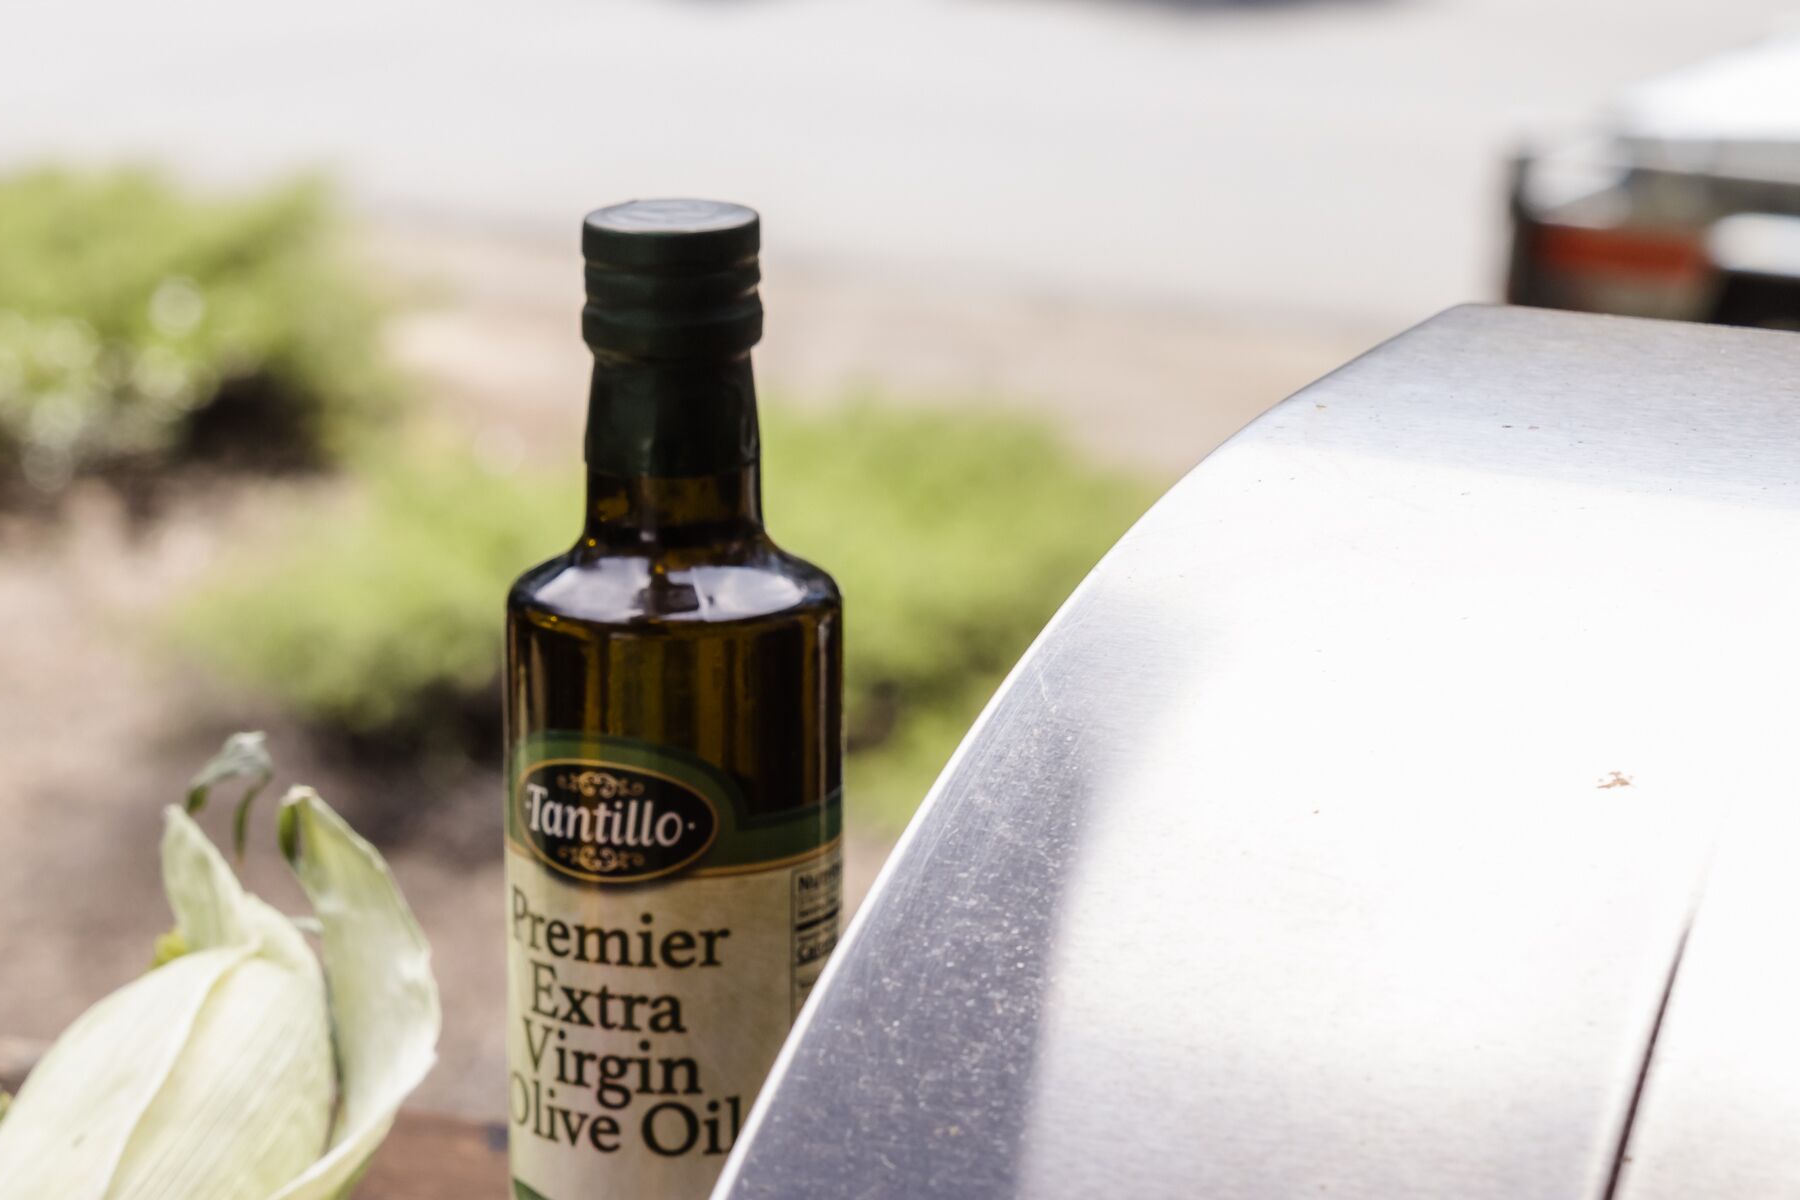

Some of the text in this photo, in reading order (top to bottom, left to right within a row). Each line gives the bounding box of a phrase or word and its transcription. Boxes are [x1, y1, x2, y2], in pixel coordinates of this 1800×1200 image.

[525, 784, 682, 847] Tantillo
[513, 887, 729, 967] Premier
[531, 962, 685, 1033] Extra
[523, 1019, 701, 1108] Virgin
[511, 1073, 740, 1156] Olive Oil
